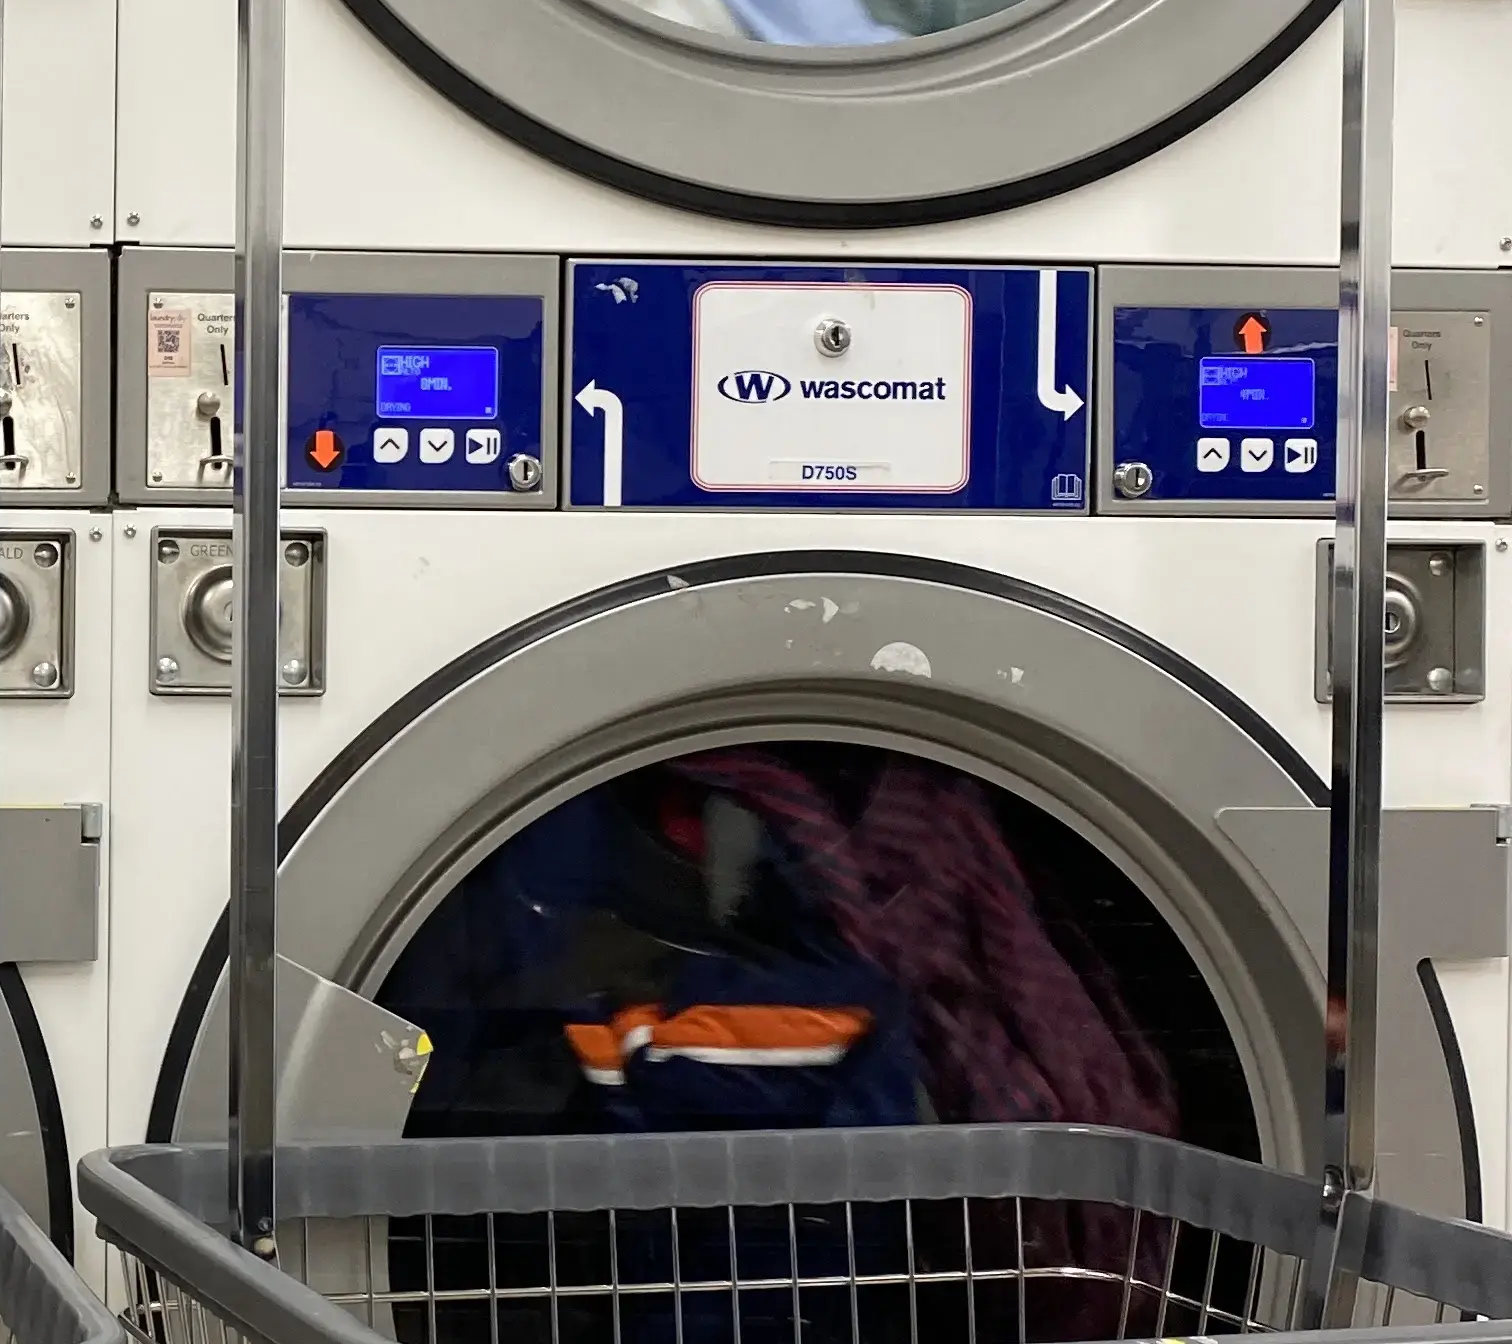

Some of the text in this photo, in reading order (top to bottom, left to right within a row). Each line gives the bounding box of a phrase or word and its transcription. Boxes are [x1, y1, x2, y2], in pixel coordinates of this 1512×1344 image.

[0, 312, 30, 321] arters
[207, 325, 229, 336] Only
[399, 355, 430, 369] HIGH
[799, 377, 947, 401] wascomat
[801, 464, 858, 481] D750S
[190, 543, 235, 558] GREEN
